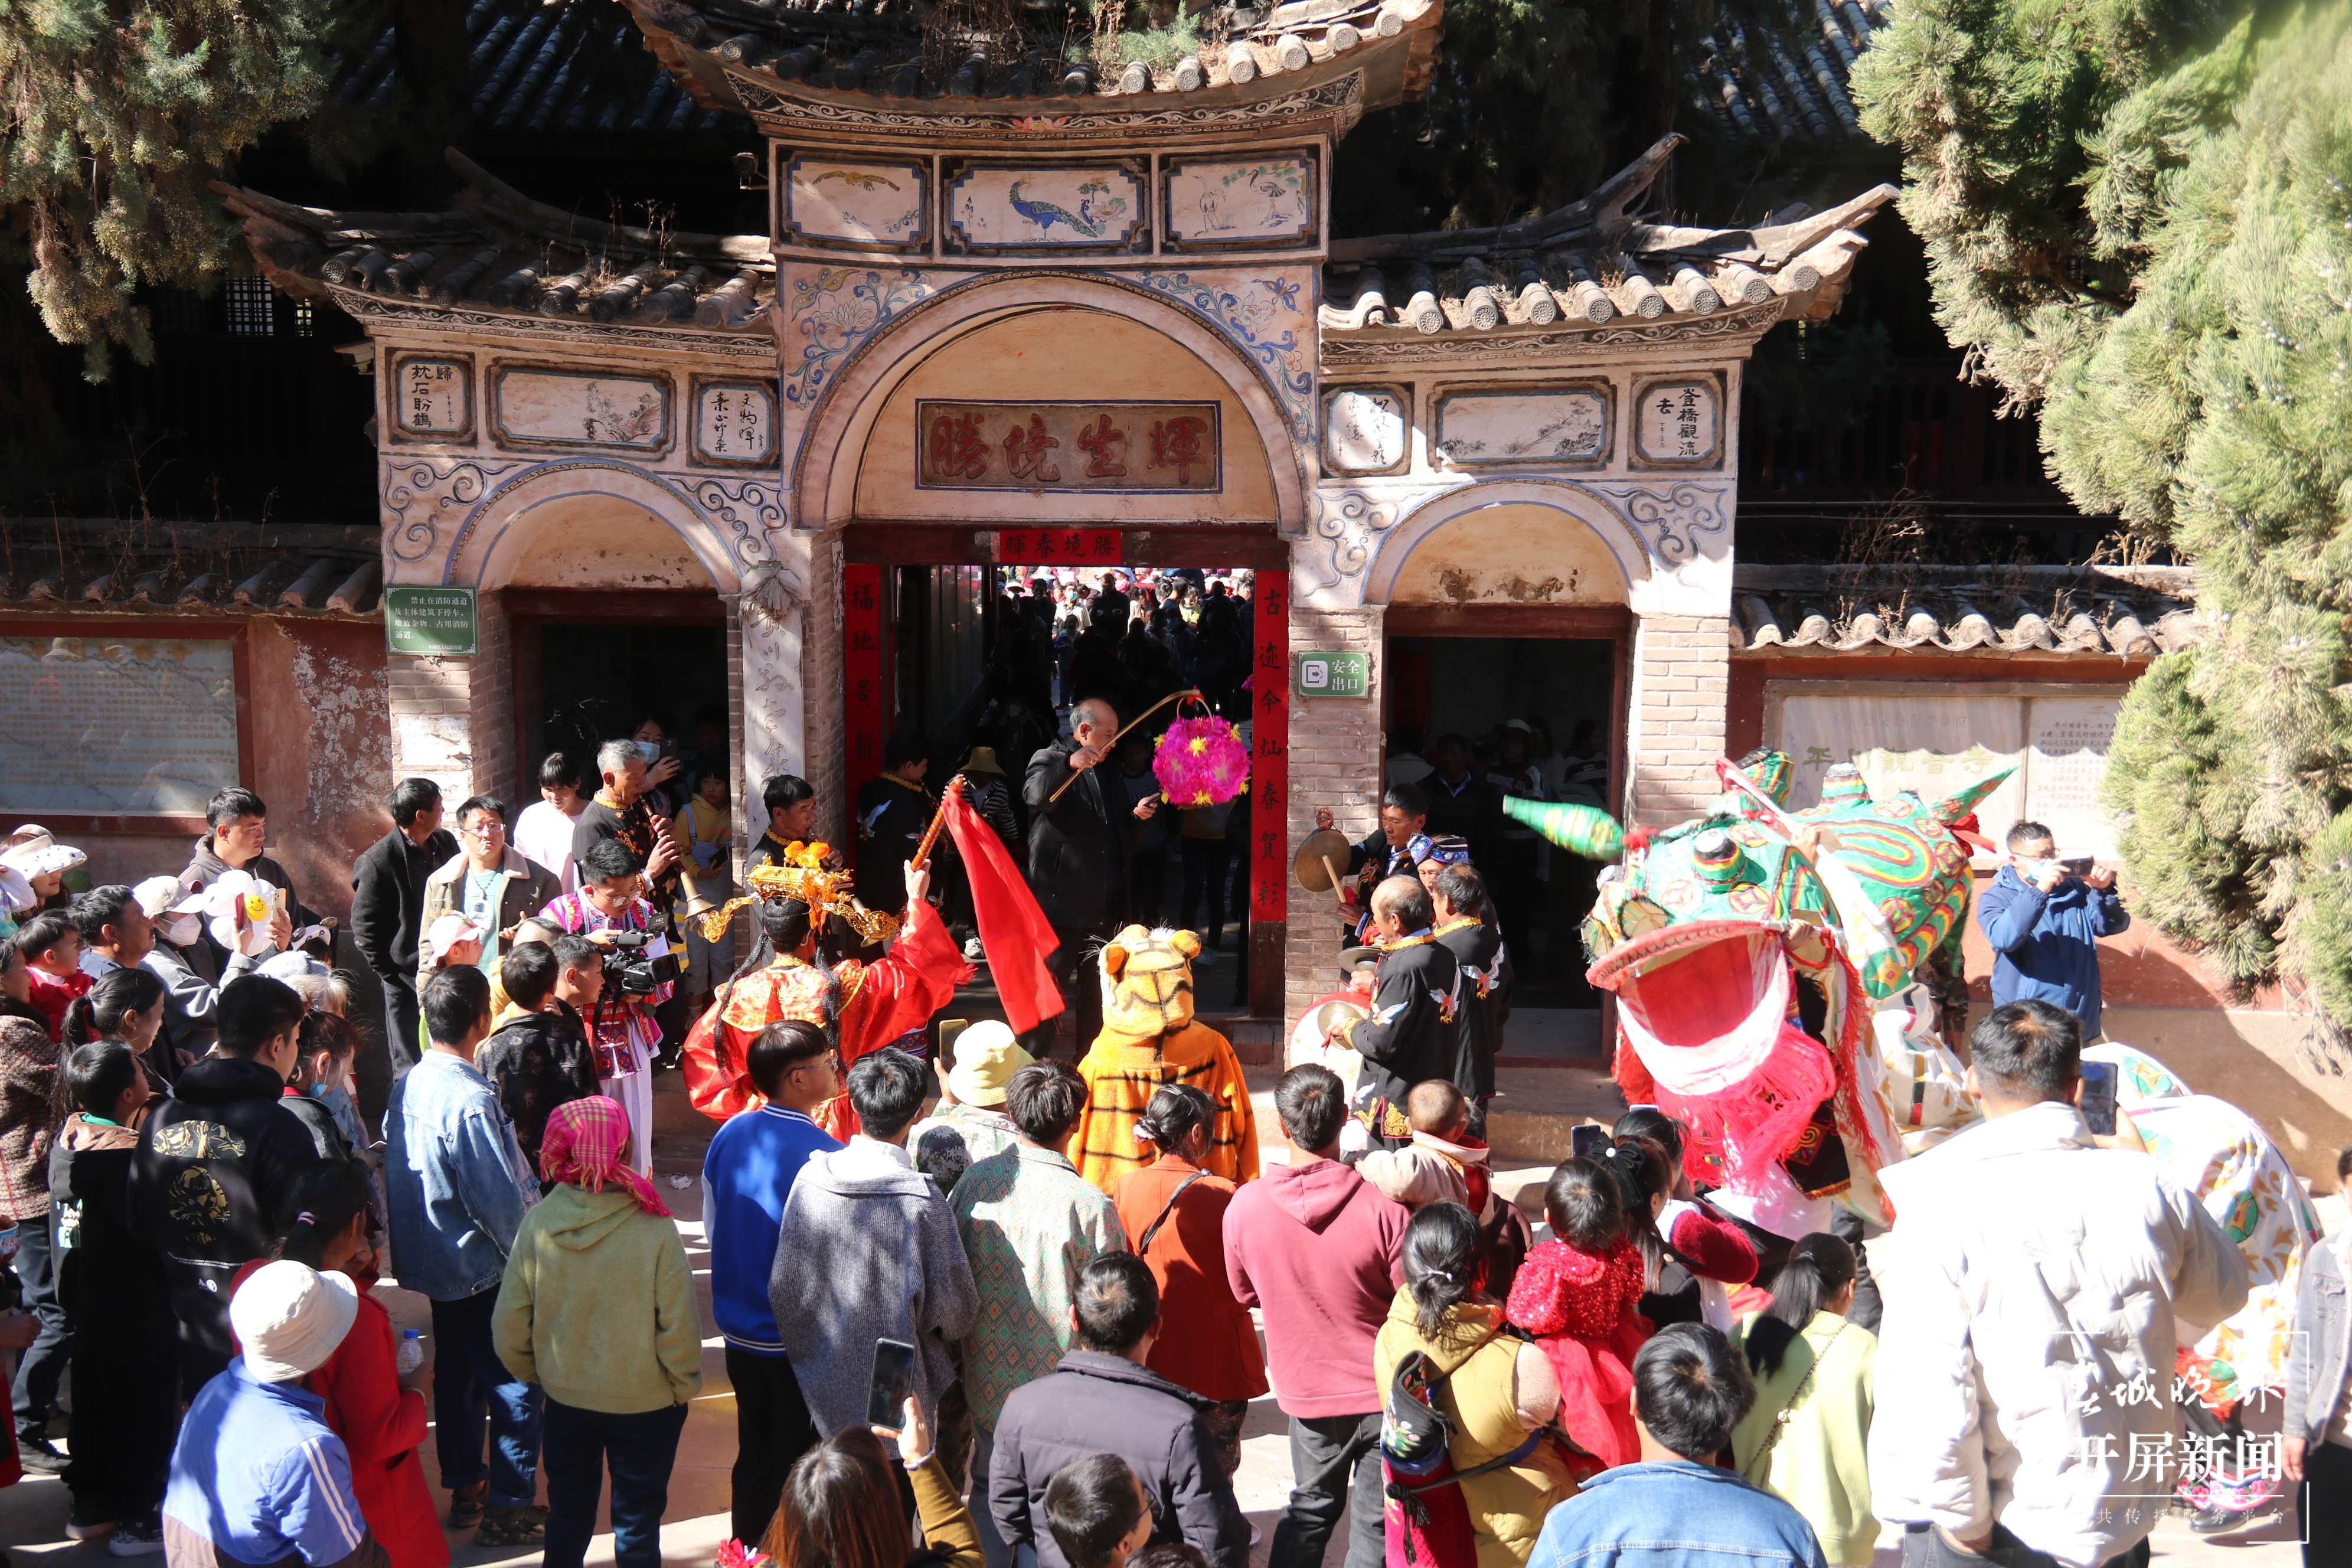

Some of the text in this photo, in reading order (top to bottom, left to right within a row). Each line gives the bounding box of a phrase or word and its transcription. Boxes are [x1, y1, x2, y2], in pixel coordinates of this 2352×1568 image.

[1656, 397, 1674, 414] 去
[410, 596, 468, 606] 禁止在消防通道
[1331, 659, 1360, 674] 安全
[1331, 676, 1358, 691] 出口
